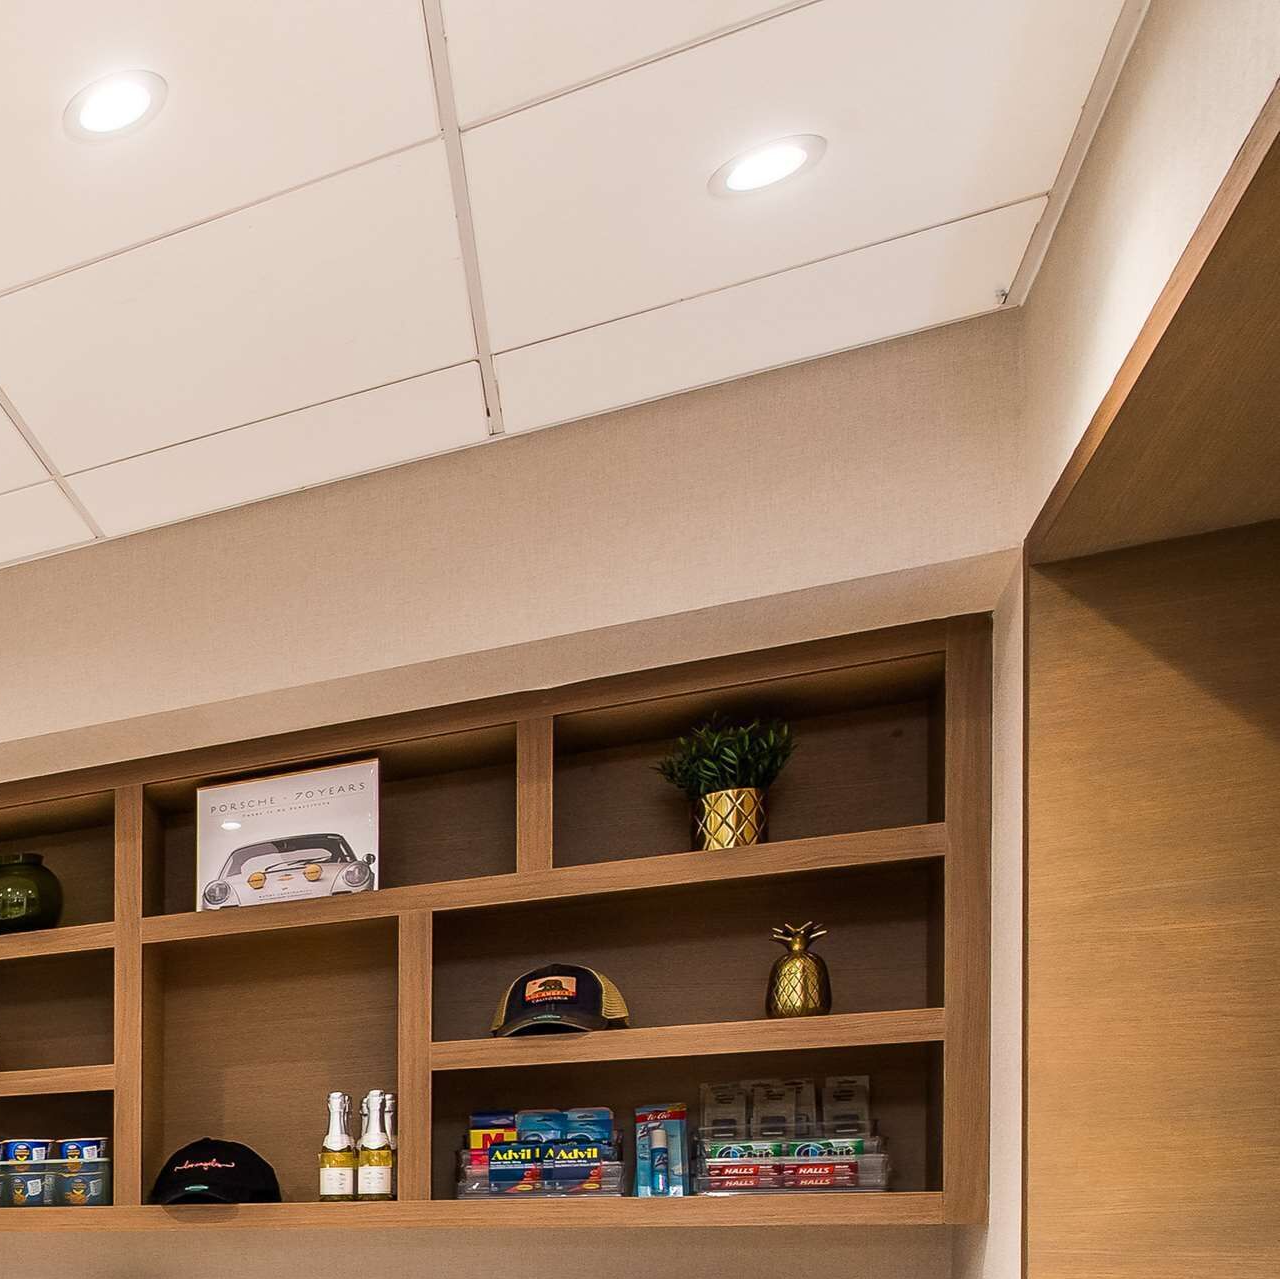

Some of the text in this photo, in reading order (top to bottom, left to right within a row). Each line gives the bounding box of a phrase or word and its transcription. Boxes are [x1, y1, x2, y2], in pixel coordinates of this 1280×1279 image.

[210, 797, 276, 814] PORSCHE
[319, 782, 366, 797] YEARS
[492, 1148, 532, 1160] Advil
[556, 1148, 598, 1160] Advil
